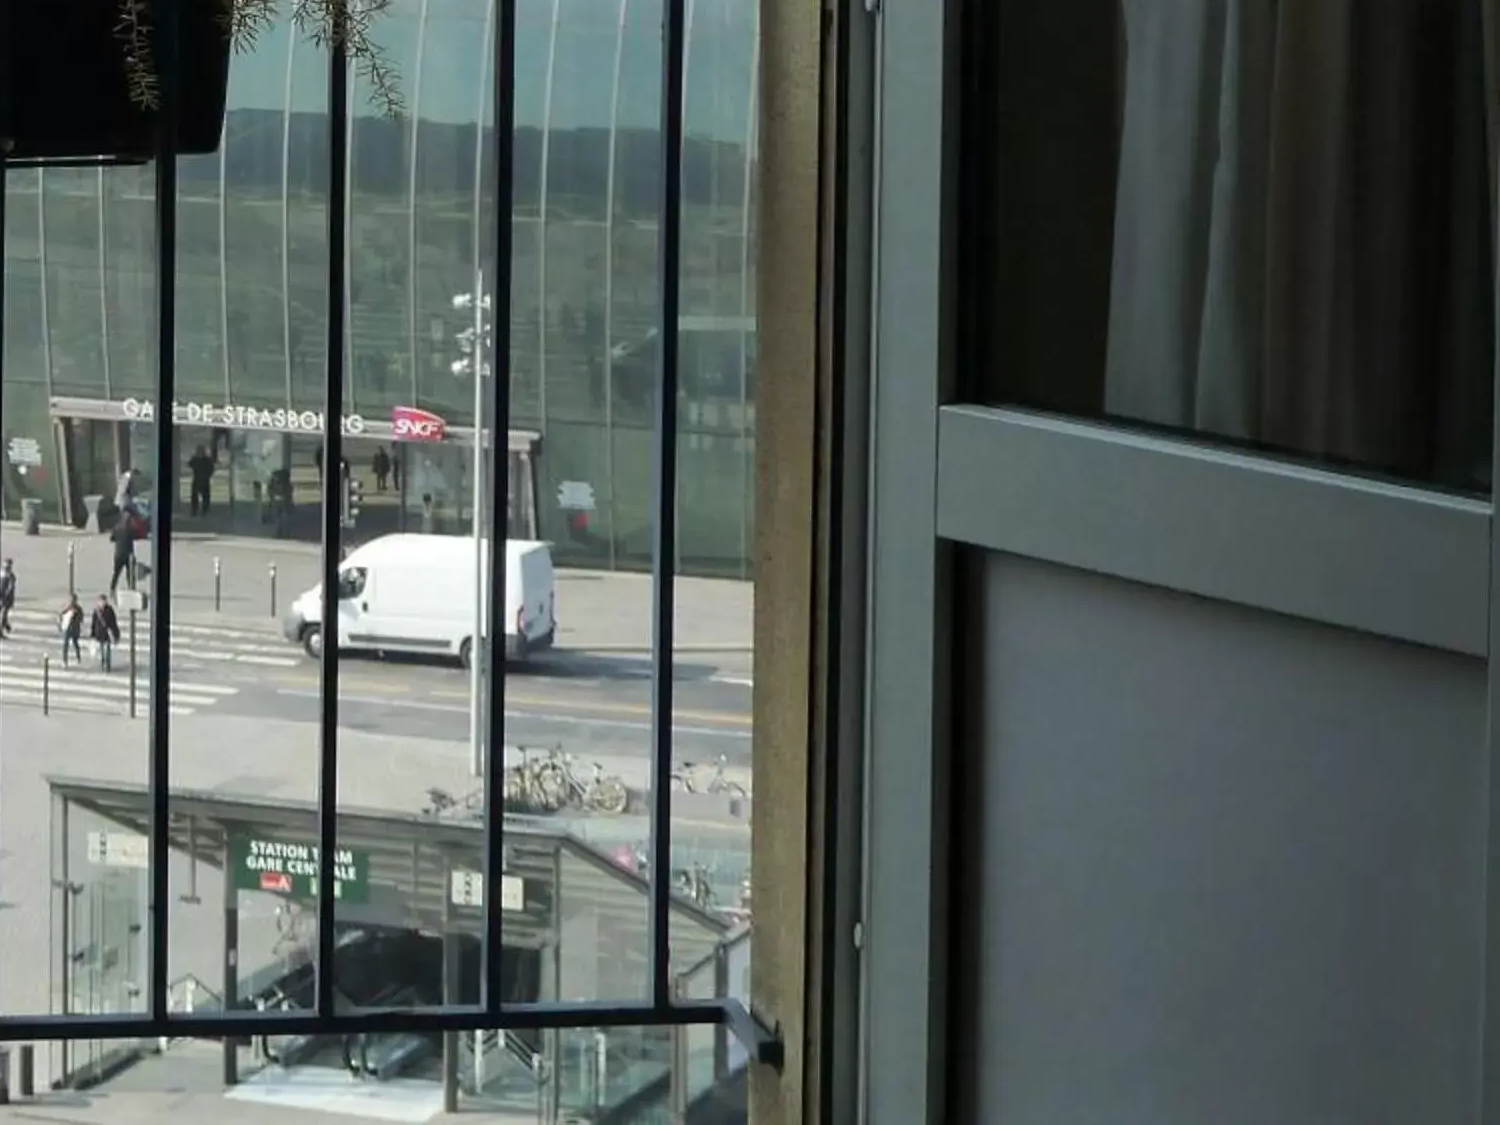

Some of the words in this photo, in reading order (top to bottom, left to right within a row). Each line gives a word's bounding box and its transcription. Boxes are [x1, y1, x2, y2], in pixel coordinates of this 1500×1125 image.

[123, 398, 178, 422] GA
[187, 402, 213, 422] DE
[395, 418, 441, 436] SNCF
[250, 840, 308, 860] STATION
[311, 847, 353, 865] TM
[245, 855, 282, 872] GARE
[287, 860, 357, 881] CENALE
